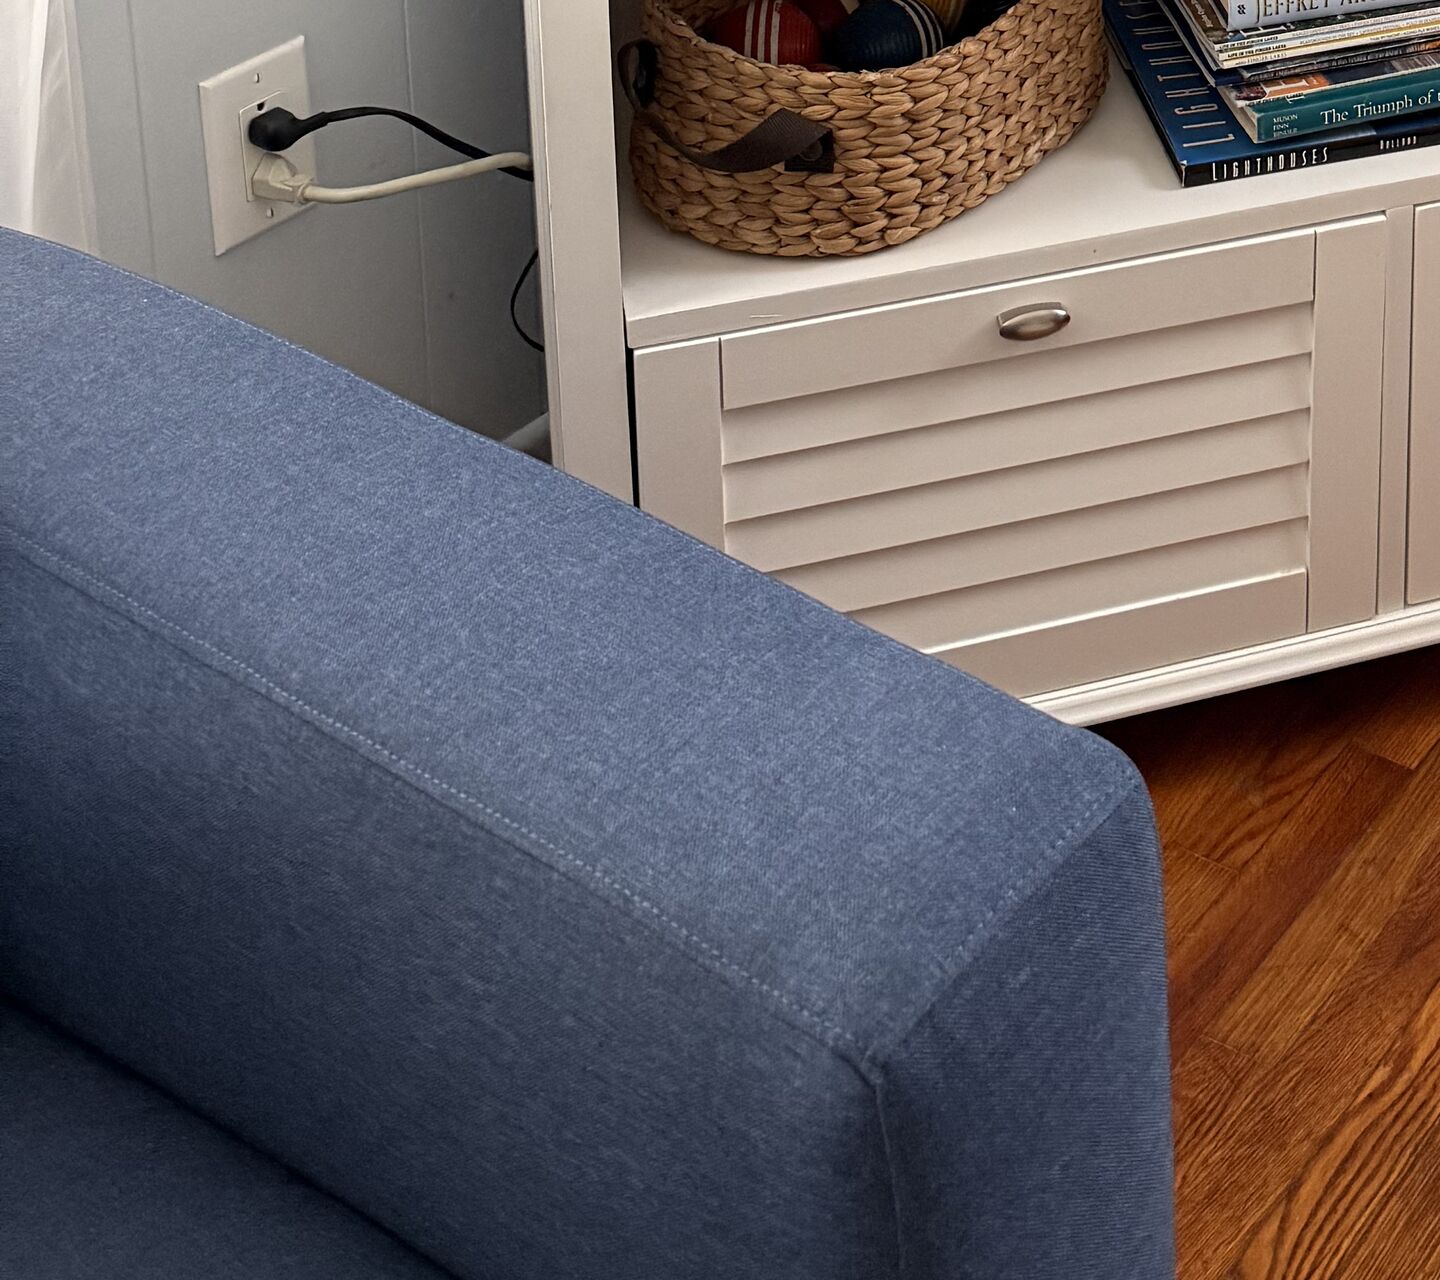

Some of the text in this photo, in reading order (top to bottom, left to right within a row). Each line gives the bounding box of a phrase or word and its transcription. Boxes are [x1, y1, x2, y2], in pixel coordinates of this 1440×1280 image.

[1320, 107, 1349, 125] The
[1353, 95, 1413, 119] Triumph
[1418, 89, 1435, 105] of
[1212, 146, 1329, 181] LIGHTHOUSES
